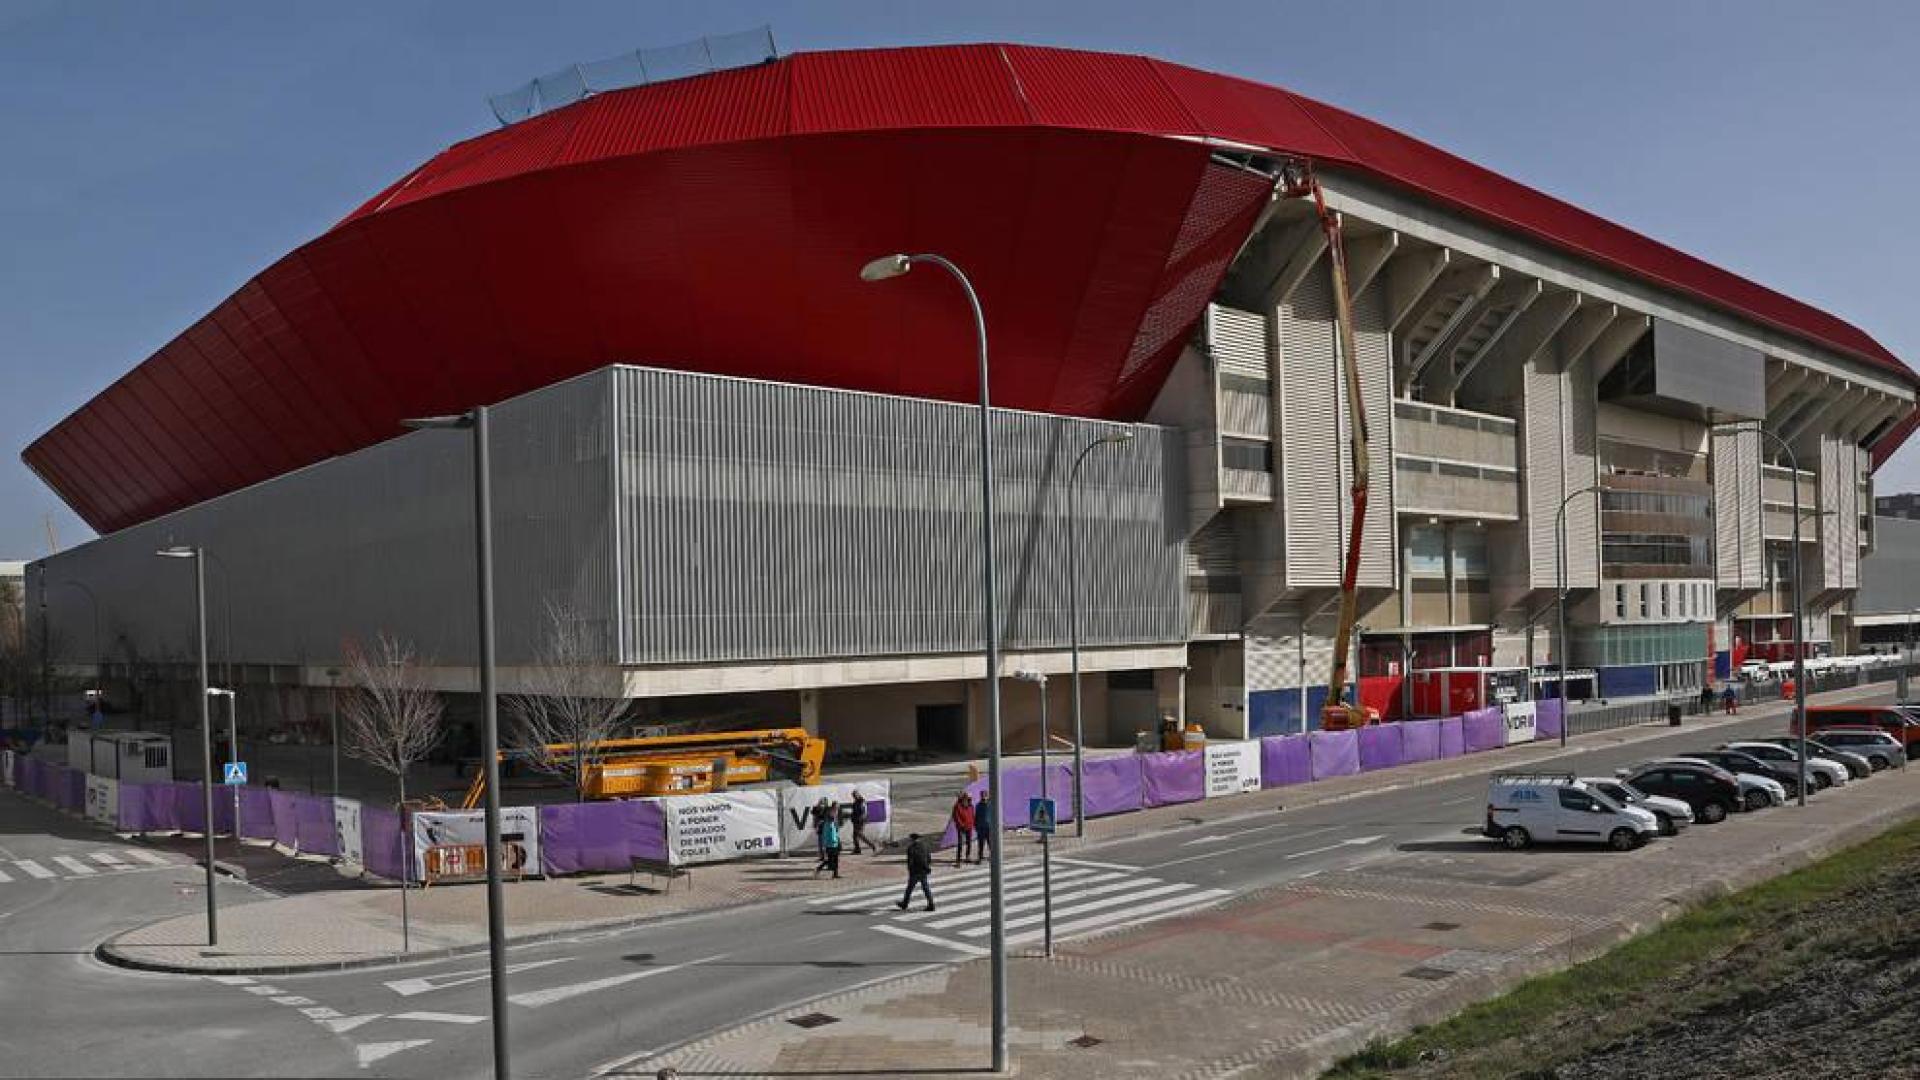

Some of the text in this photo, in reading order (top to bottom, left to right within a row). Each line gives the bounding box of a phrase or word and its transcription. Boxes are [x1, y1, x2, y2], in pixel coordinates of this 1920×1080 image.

[680, 824, 726, 835] MORADOS
[680, 838, 692, 848] DE
[734, 837, 763, 850] VDR
